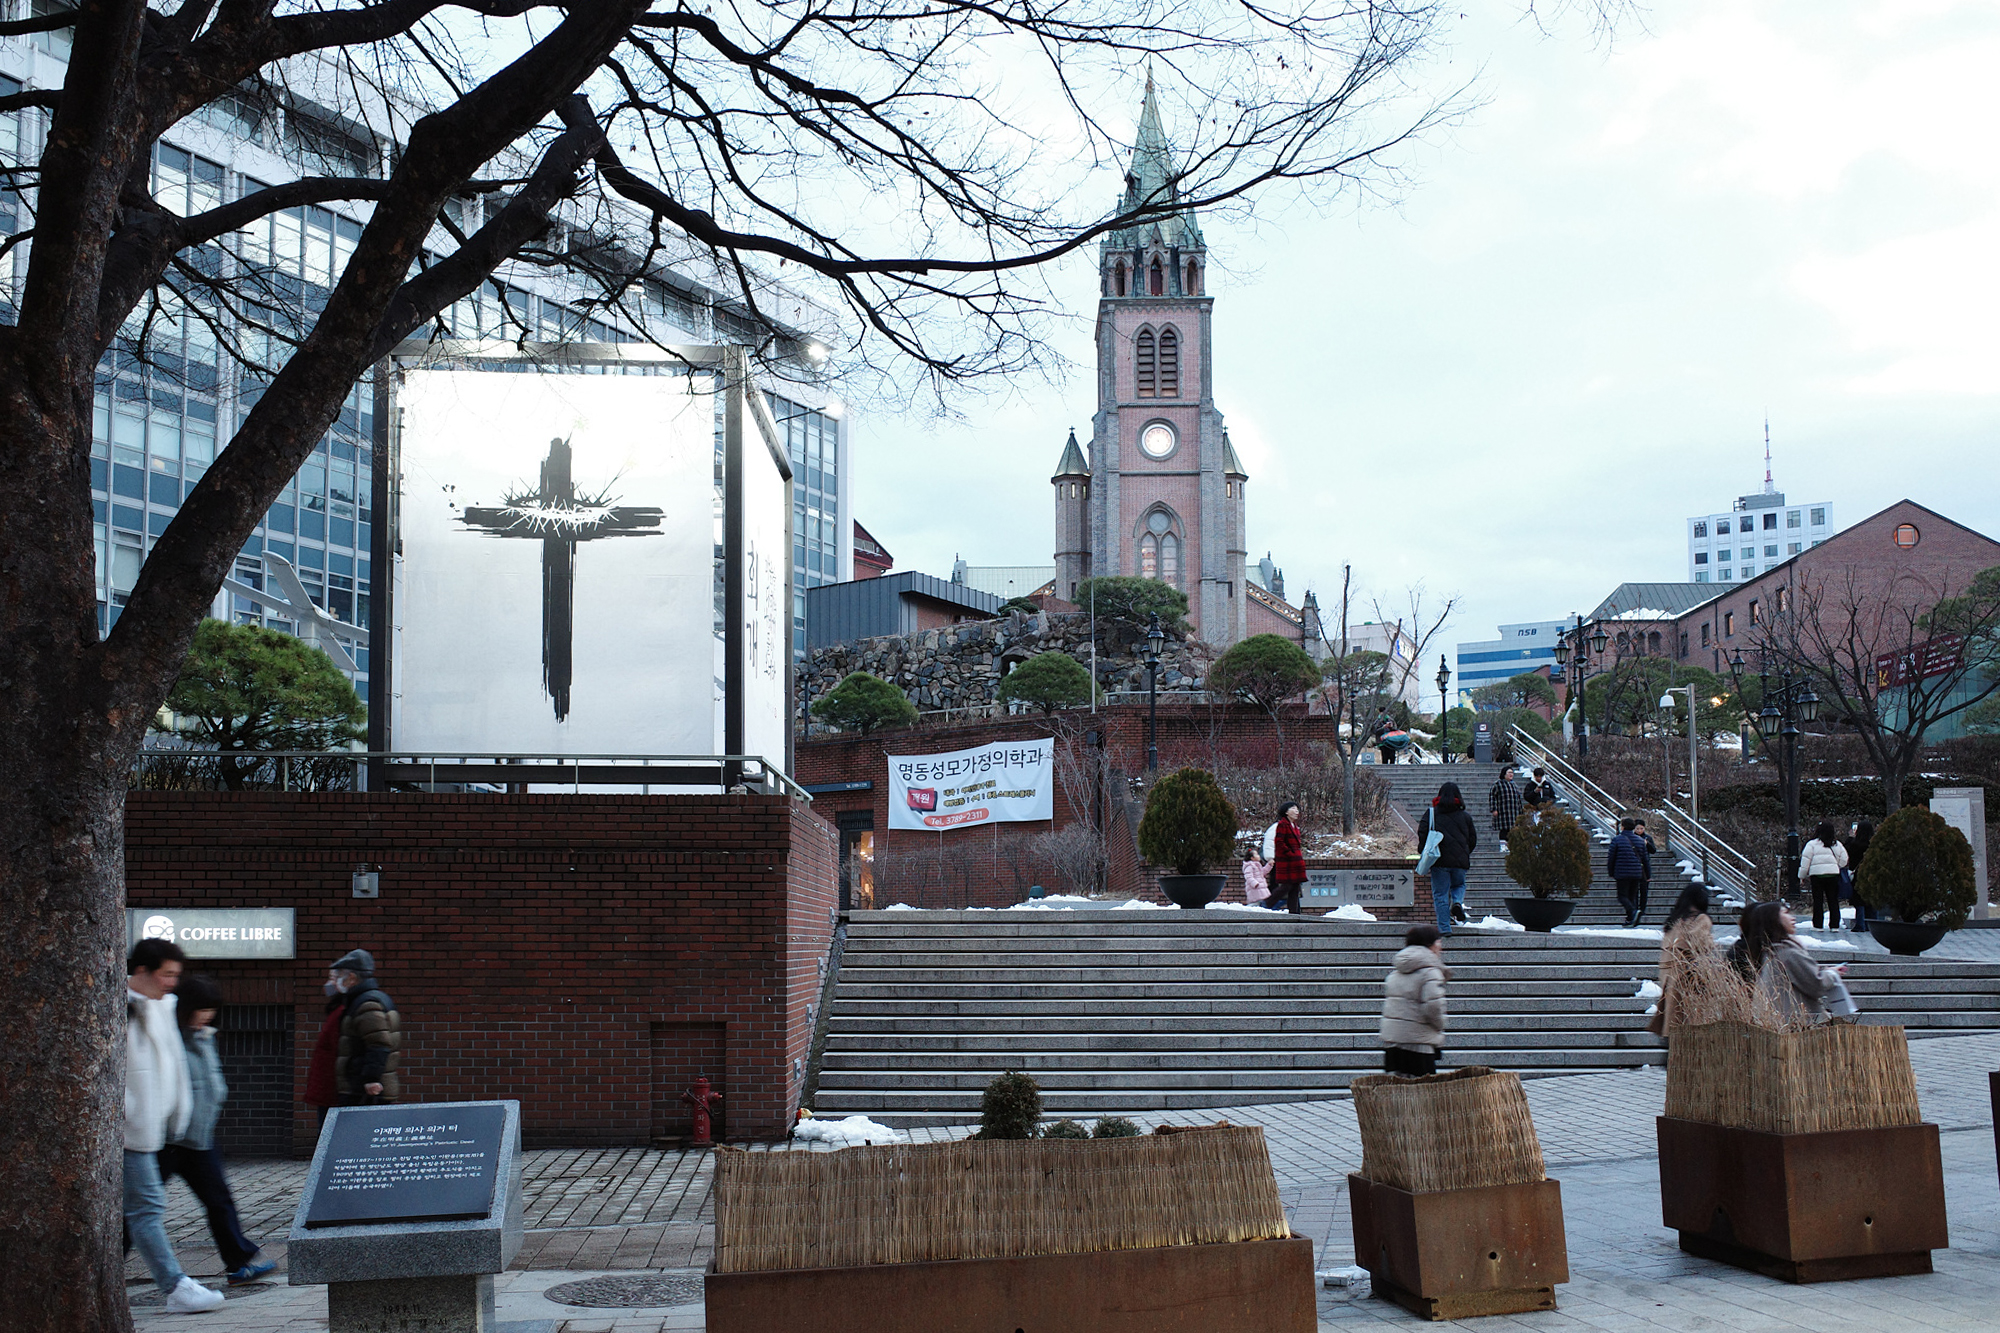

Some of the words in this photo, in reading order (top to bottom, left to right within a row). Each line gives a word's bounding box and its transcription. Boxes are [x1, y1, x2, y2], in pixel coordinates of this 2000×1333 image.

[899, 747, 1043, 781] 명동성모가정의학과
[911, 793, 930, 804] 개원
[931, 817, 944, 826] Tel.
[946, 810, 983, 825] 3789-2311
[1310, 874, 1337, 882] 명동성당
[180, 927, 237, 941] COFFEE
[241, 927, 282, 941] LIBRE
[374, 1126, 402, 1135] 이재명
[405, 1126, 424, 1134] 의사
[427, 1124, 446, 1133] 의거
